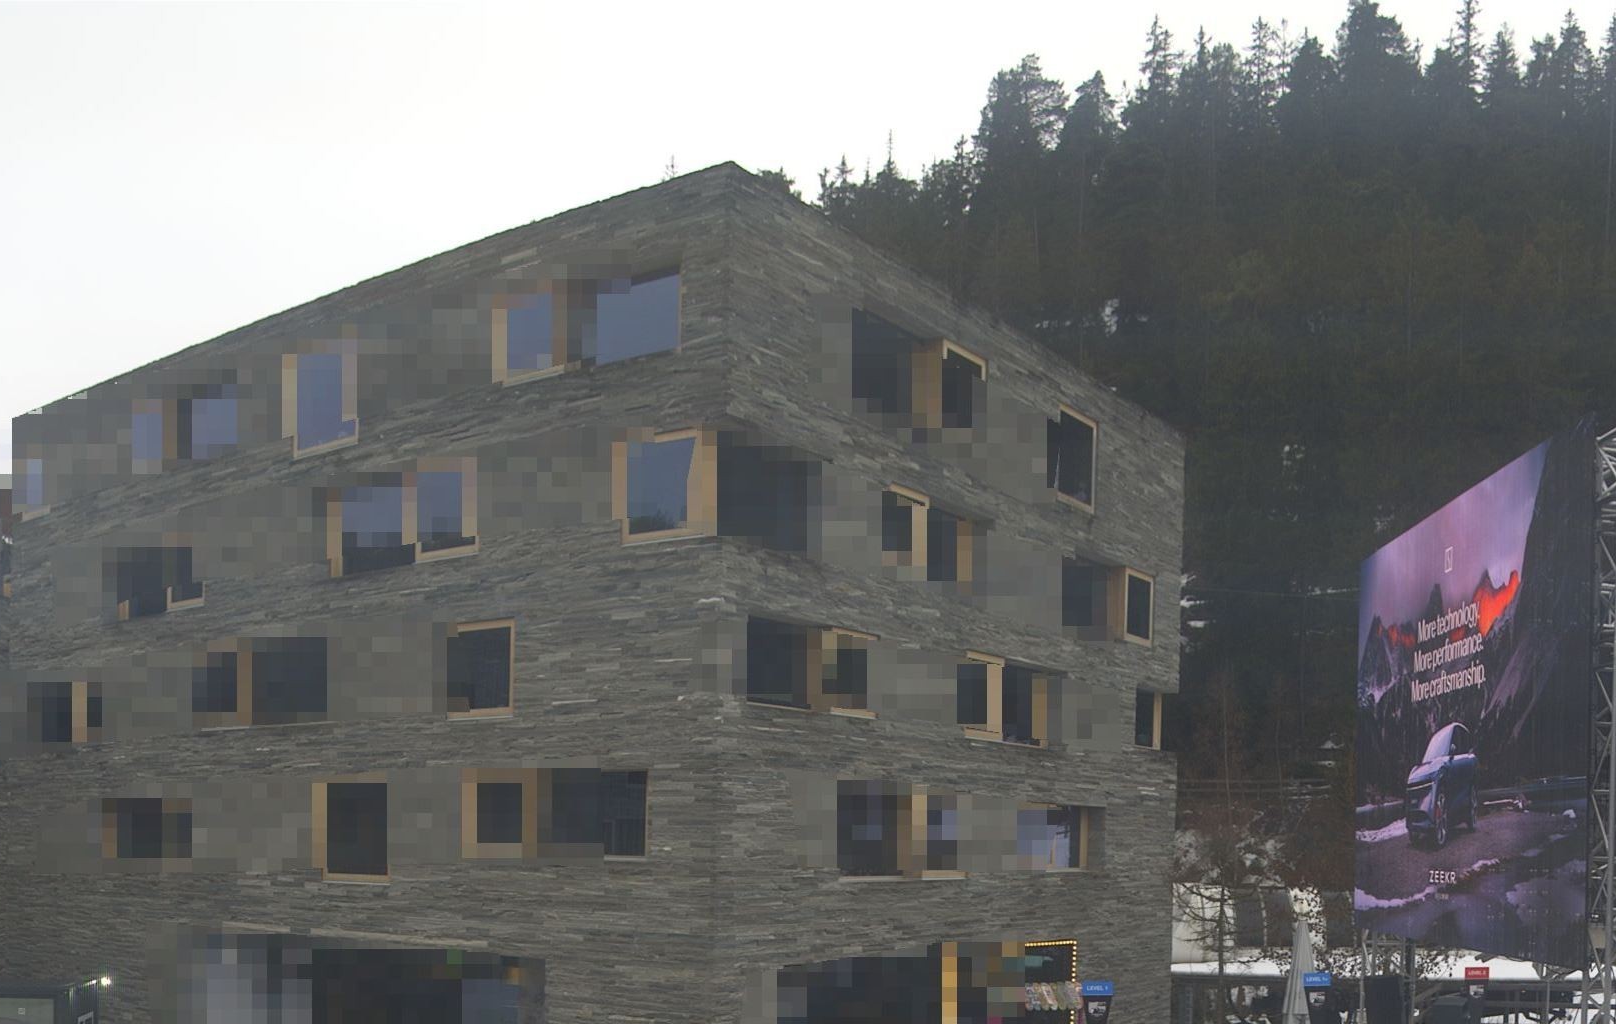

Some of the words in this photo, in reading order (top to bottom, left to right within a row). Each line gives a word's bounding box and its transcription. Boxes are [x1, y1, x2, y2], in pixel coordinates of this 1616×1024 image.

[1417, 618, 1436, 644] More
[1436, 600, 1480, 636] technology.
[1414, 650, 1432, 674] More
[1432, 632, 1484, 672] performance.
[1411, 679, 1429, 703] More
[1429, 659, 1486, 699] craftsmanship.
[1429, 870, 1457, 884] ZEEKR
